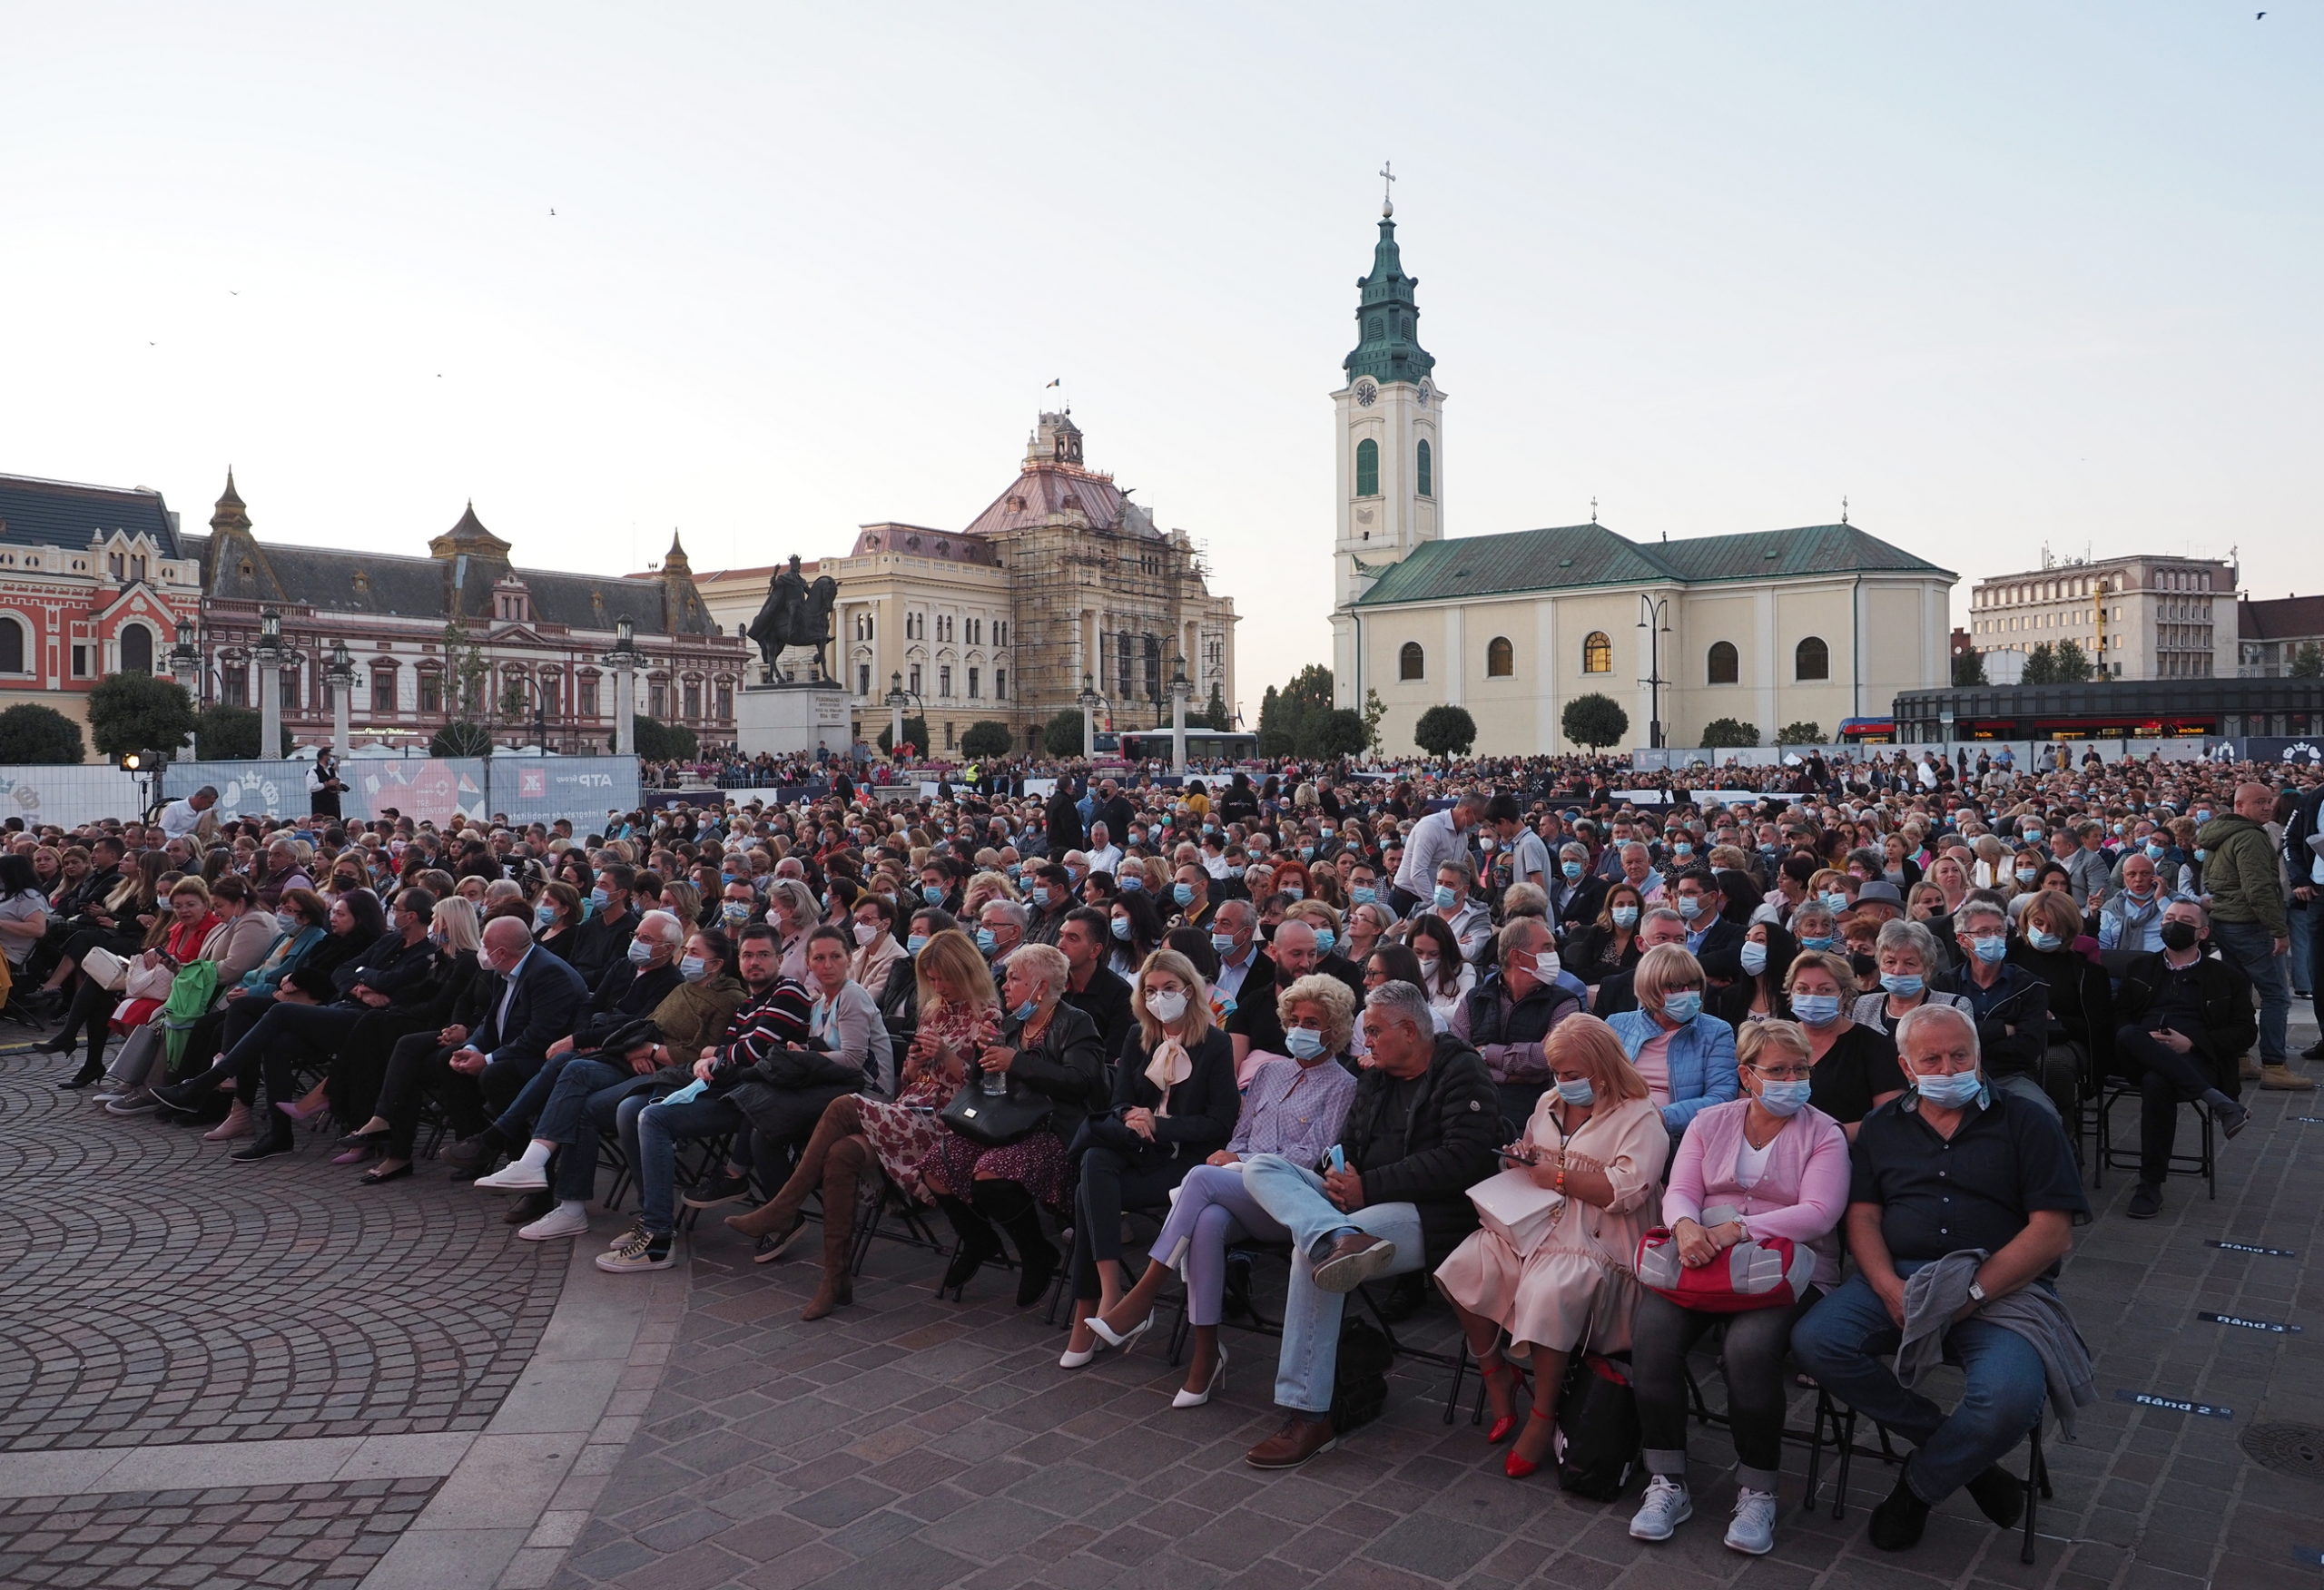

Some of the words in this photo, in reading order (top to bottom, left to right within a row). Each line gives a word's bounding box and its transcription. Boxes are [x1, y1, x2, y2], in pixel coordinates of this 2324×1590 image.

[2220, 1242, 2264, 1253] Rând
[2217, 1315, 2267, 1330] Rând
[2271, 1323, 2284, 1332] 3
[2136, 1395, 2192, 1411] Rând
[2197, 1406, 2211, 1415] 2
